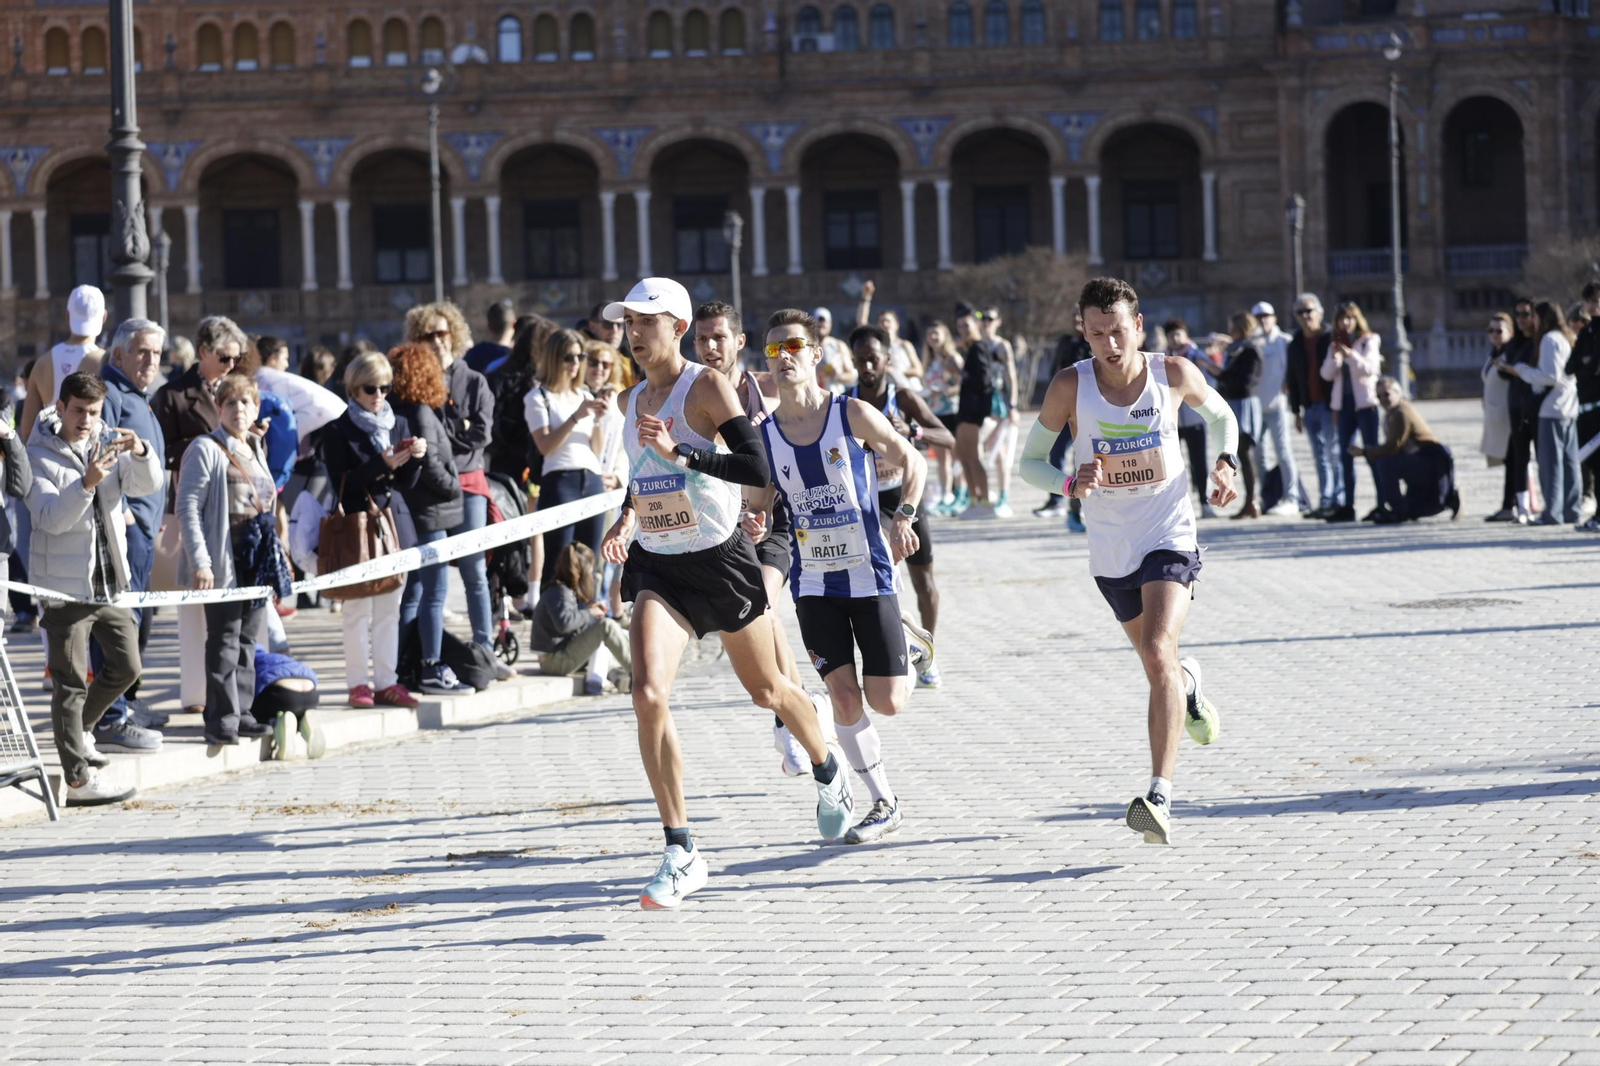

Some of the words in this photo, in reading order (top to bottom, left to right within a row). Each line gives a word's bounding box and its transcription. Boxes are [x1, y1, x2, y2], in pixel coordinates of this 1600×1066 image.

[1130, 406, 1159, 419] sparta
[1115, 437, 1153, 451] ZURICH
[1121, 459, 1137, 468] 118
[1108, 468, 1154, 485] LEONID
[642, 479, 676, 491] ZURICH
[792, 483, 846, 503] GIPUZKOA
[649, 501, 663, 511] 208
[797, 494, 846, 513] KIROLAK
[639, 511, 690, 530] BERMEJO
[813, 514, 849, 526] ZURICH
[811, 543, 848, 558] IRATIZ
